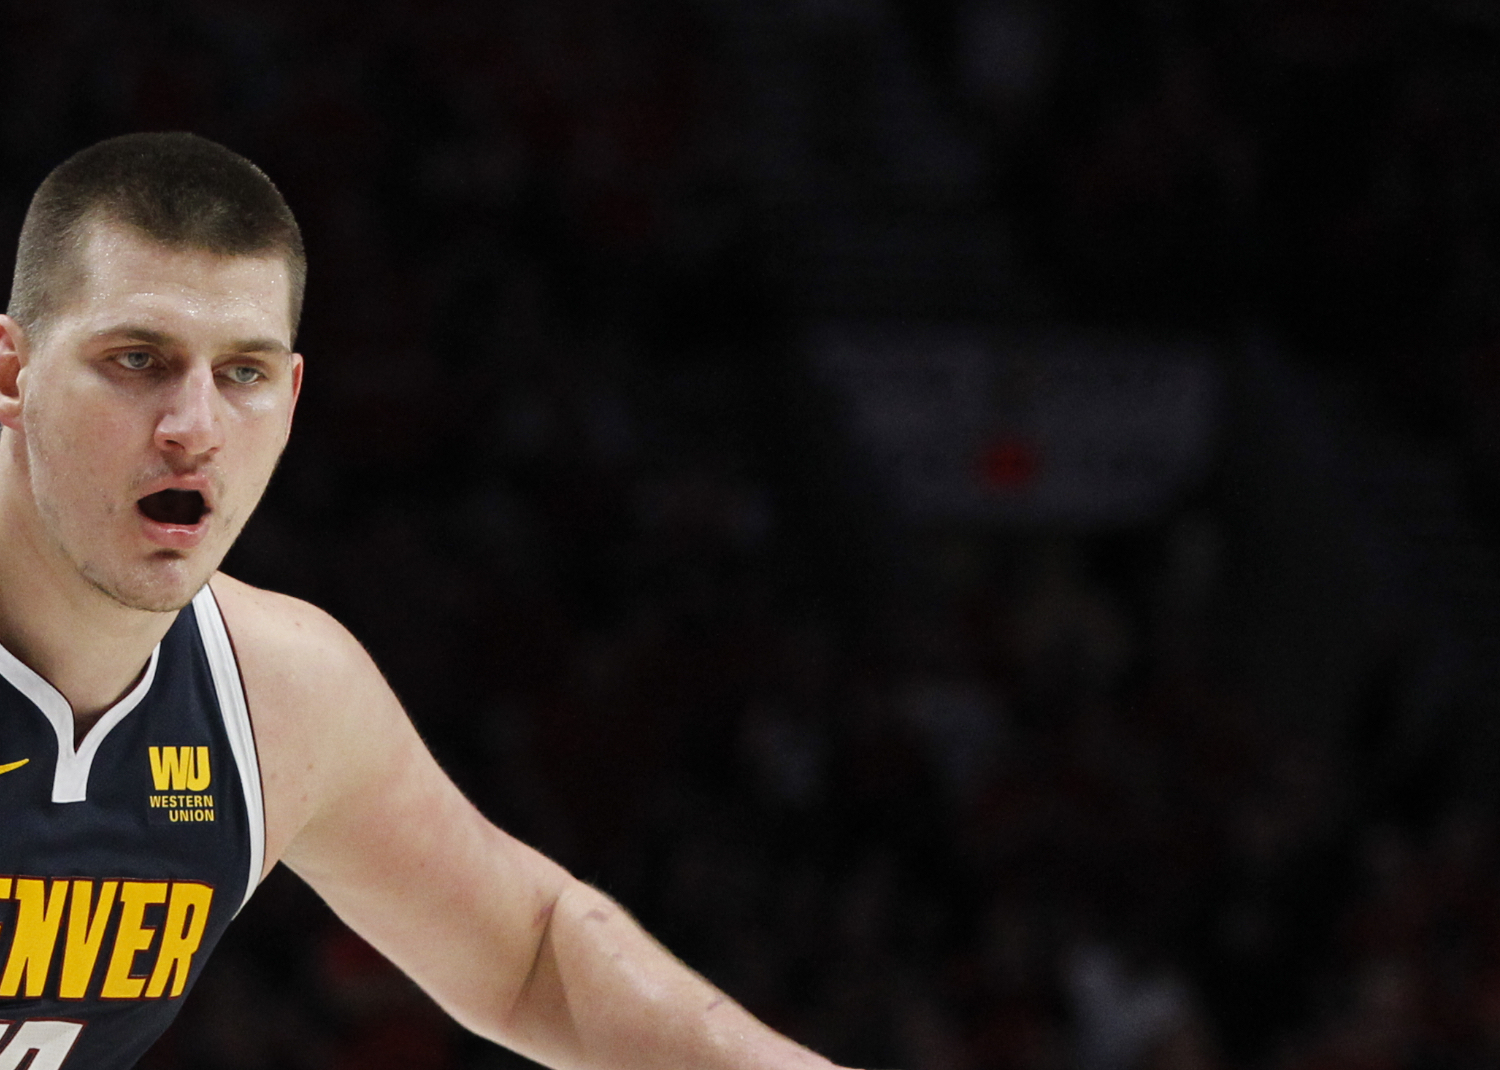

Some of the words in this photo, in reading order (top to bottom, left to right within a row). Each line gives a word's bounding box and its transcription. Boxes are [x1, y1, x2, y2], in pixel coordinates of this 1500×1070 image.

[148, 746, 211, 791] WU
[149, 795, 214, 808] WESTERN
[169, 809, 215, 822] UNION
